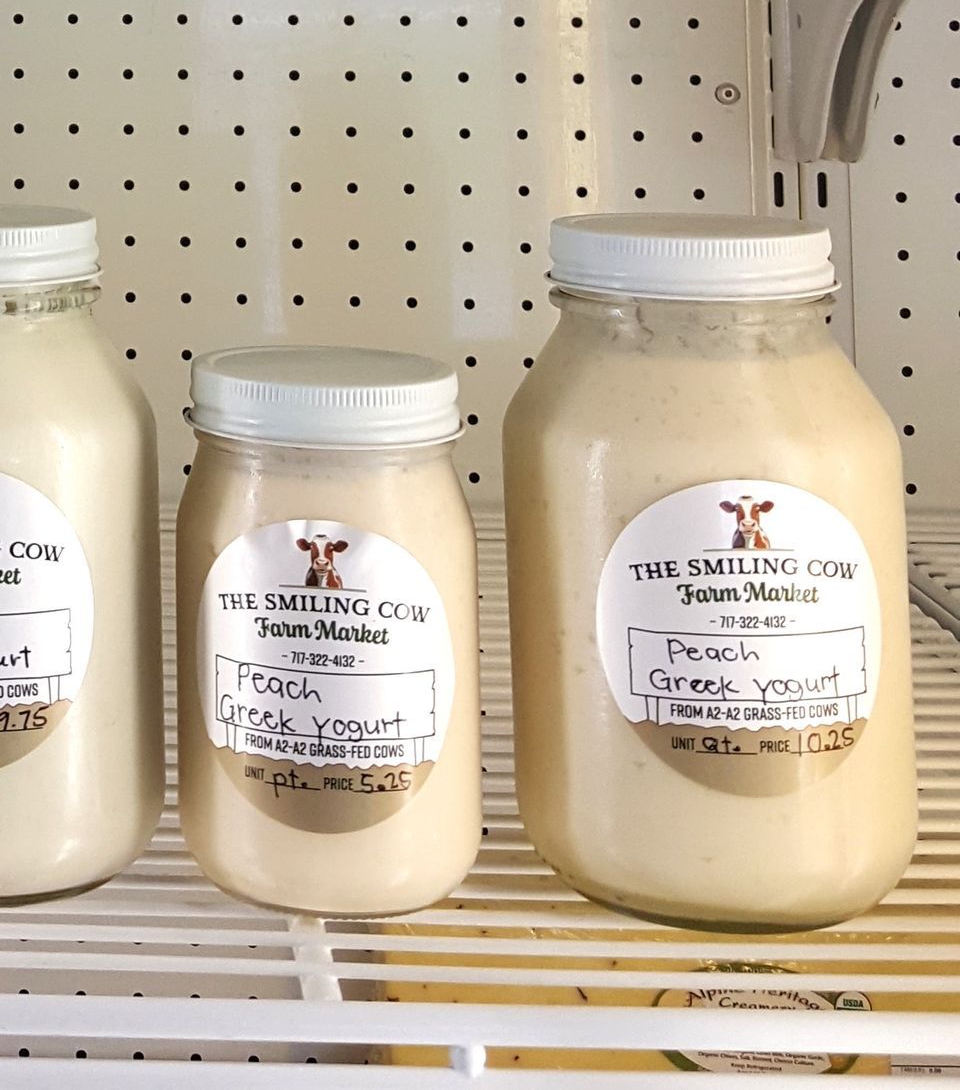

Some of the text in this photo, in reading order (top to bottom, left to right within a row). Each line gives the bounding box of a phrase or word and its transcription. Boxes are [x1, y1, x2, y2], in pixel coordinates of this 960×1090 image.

[9, 541, 64, 562] COW
[629, 558, 858, 581] THE SMILING COW
[676, 581, 820, 605] Farm Market
[218, 593, 431, 623] THE SMILING COW
[254, 616, 390, 645] Farm Market
[719, 616, 786, 628] 717-322-4132
[291, 651, 355, 668] 717-322-4132
[666, 638, 759, 664] Peach
[7, 683, 38, 697] COWS
[238, 663, 321, 703] Peach
[649, 669, 739, 700] Greek
[220, 694, 296, 735] Greek
[744, 704, 838, 720] GRASS-FED COWS
[310, 743, 370, 759] GRASS-FED
[759, 739, 789, 753] PRICE
[798, 727, 854, 756] 10.25
[323, 777, 354, 791] PRICE
[361, 771, 412, 793] 5.25
[842, 998, 863, 1008] USDA
